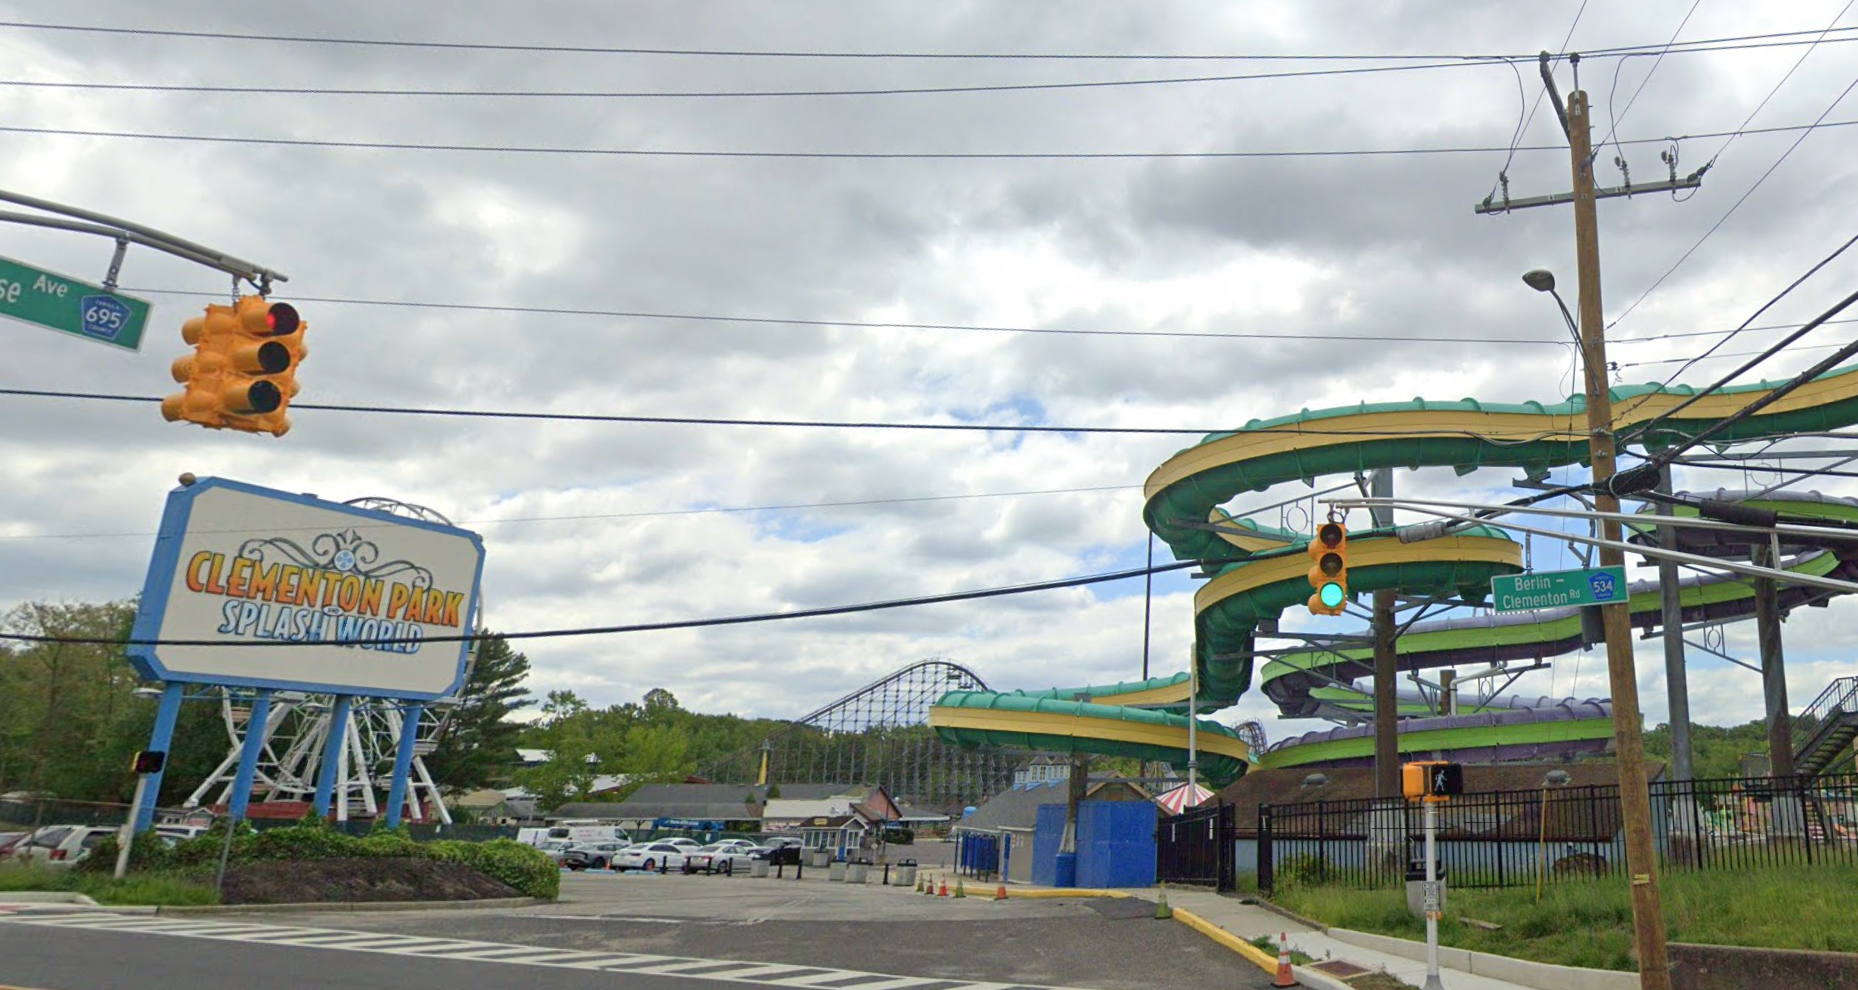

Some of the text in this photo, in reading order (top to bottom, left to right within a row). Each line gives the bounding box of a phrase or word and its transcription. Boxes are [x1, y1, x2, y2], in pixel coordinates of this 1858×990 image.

[33, 274, 68, 298] Ave
[85, 306, 122, 329] 695
[186, 550, 465, 628] CLEMENTON PARK
[1514, 577, 1551, 592] Berlin
[1592, 580, 1613, 593] 534
[1502, 592, 1568, 609] Clementon
[1569, 589, 1581, 599] Rd
[218, 599, 424, 655] SPLASH WORLD
